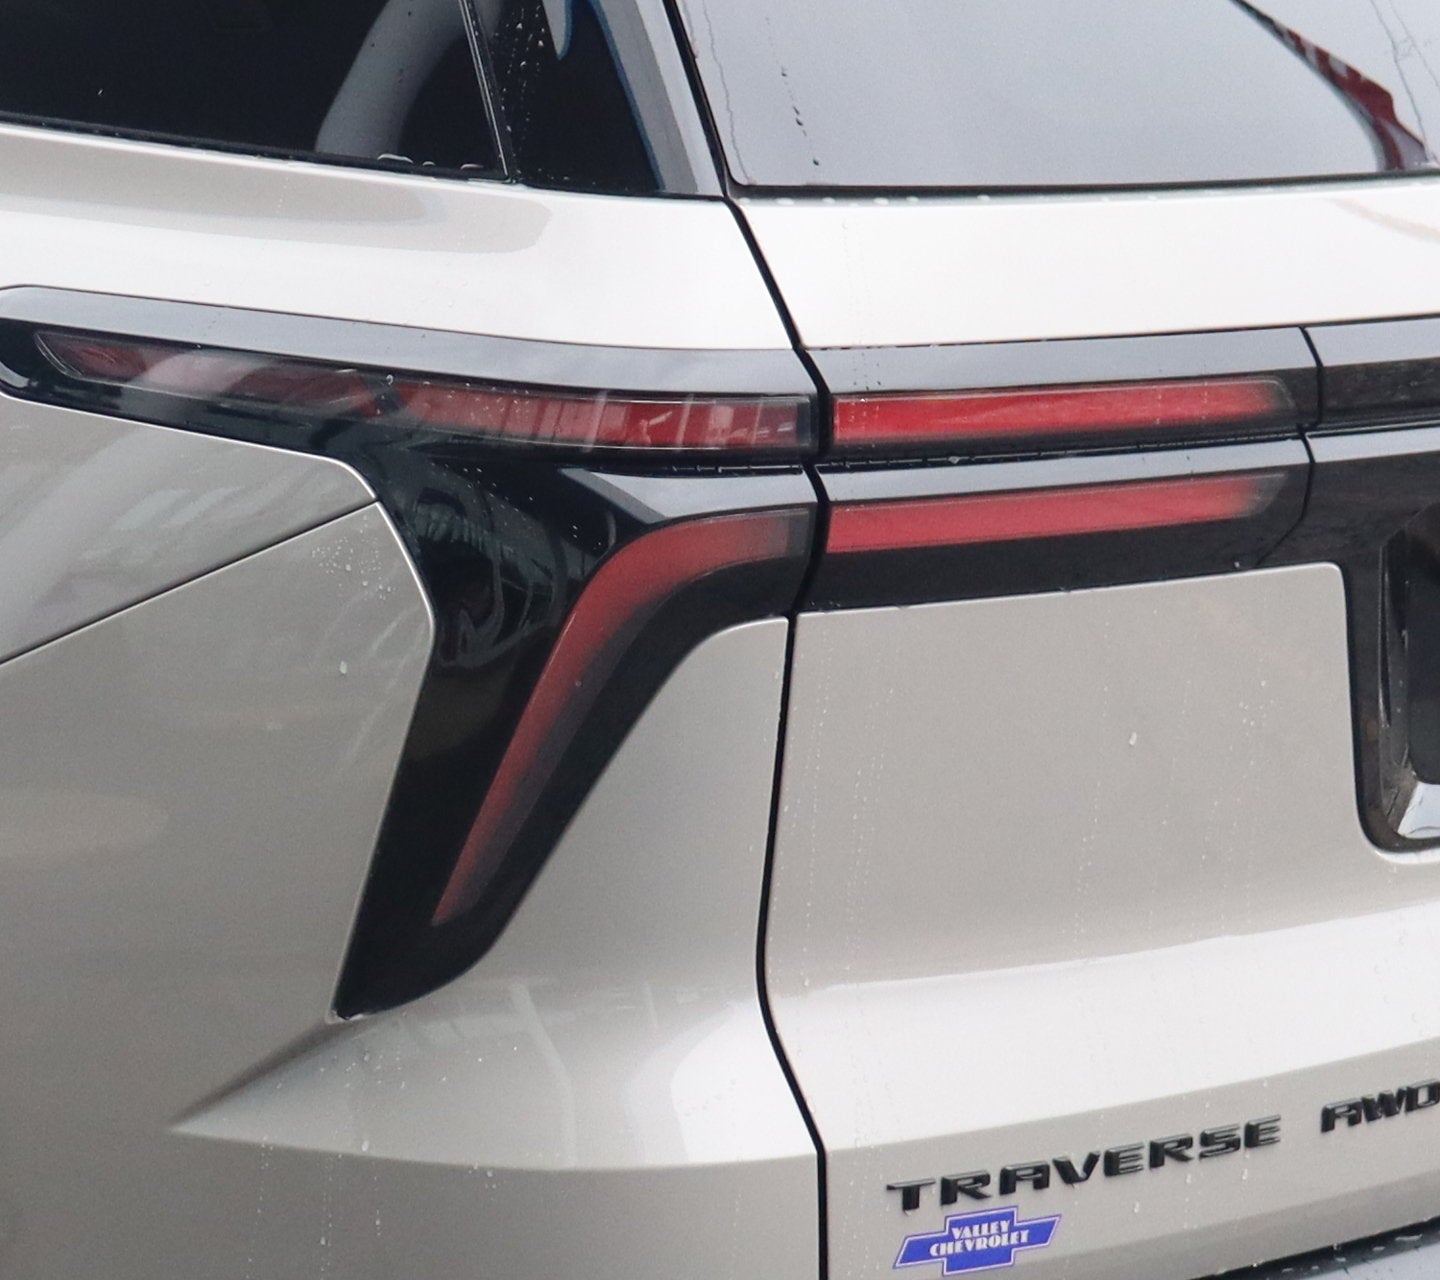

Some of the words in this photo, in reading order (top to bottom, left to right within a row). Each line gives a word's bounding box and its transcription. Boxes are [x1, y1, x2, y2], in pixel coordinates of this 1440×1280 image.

[886, 1114, 1282, 1212] TRAVERSE
[951, 1219, 1012, 1240] VALLEY
[929, 1230, 1029, 1257] CHEVROLET
